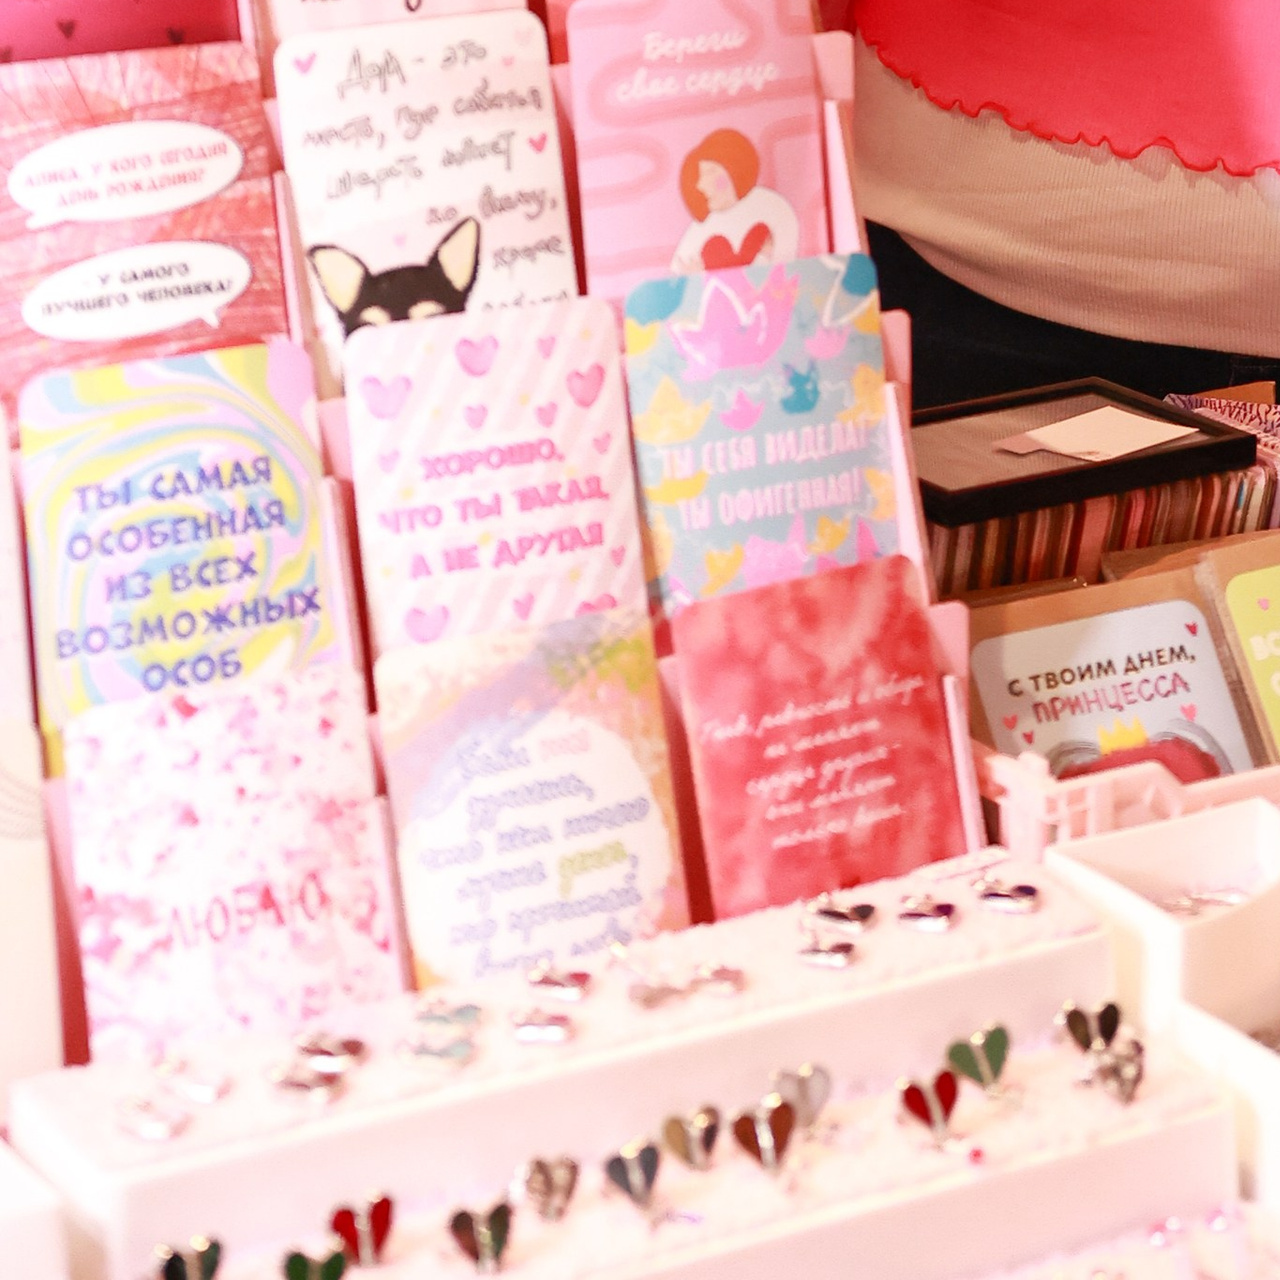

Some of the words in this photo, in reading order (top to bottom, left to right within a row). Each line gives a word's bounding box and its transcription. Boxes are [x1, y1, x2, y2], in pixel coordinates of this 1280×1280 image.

[74, 477, 132, 513] ТЫ
[150, 455, 272, 501] САМАЯ
[68, 499, 286, 562] ОСОБЕННАЯ
[378, 504, 443, 534] ЧТО
[106, 569, 151, 602] ИЗ
[170, 551, 258, 593] ВСЕХ
[410, 553, 432, 579] А
[55, 586, 322, 660] ВОЗМОЖНЫХ
[143, 647, 243, 692] ОСОБ
[1008, 678, 1024, 697] С
[1029, 659, 1117, 692] ТВОИМ
[1123, 645, 1196, 676] ДНЕМ,
[1032, 672, 1191, 724] ПРИНЦЕССА
